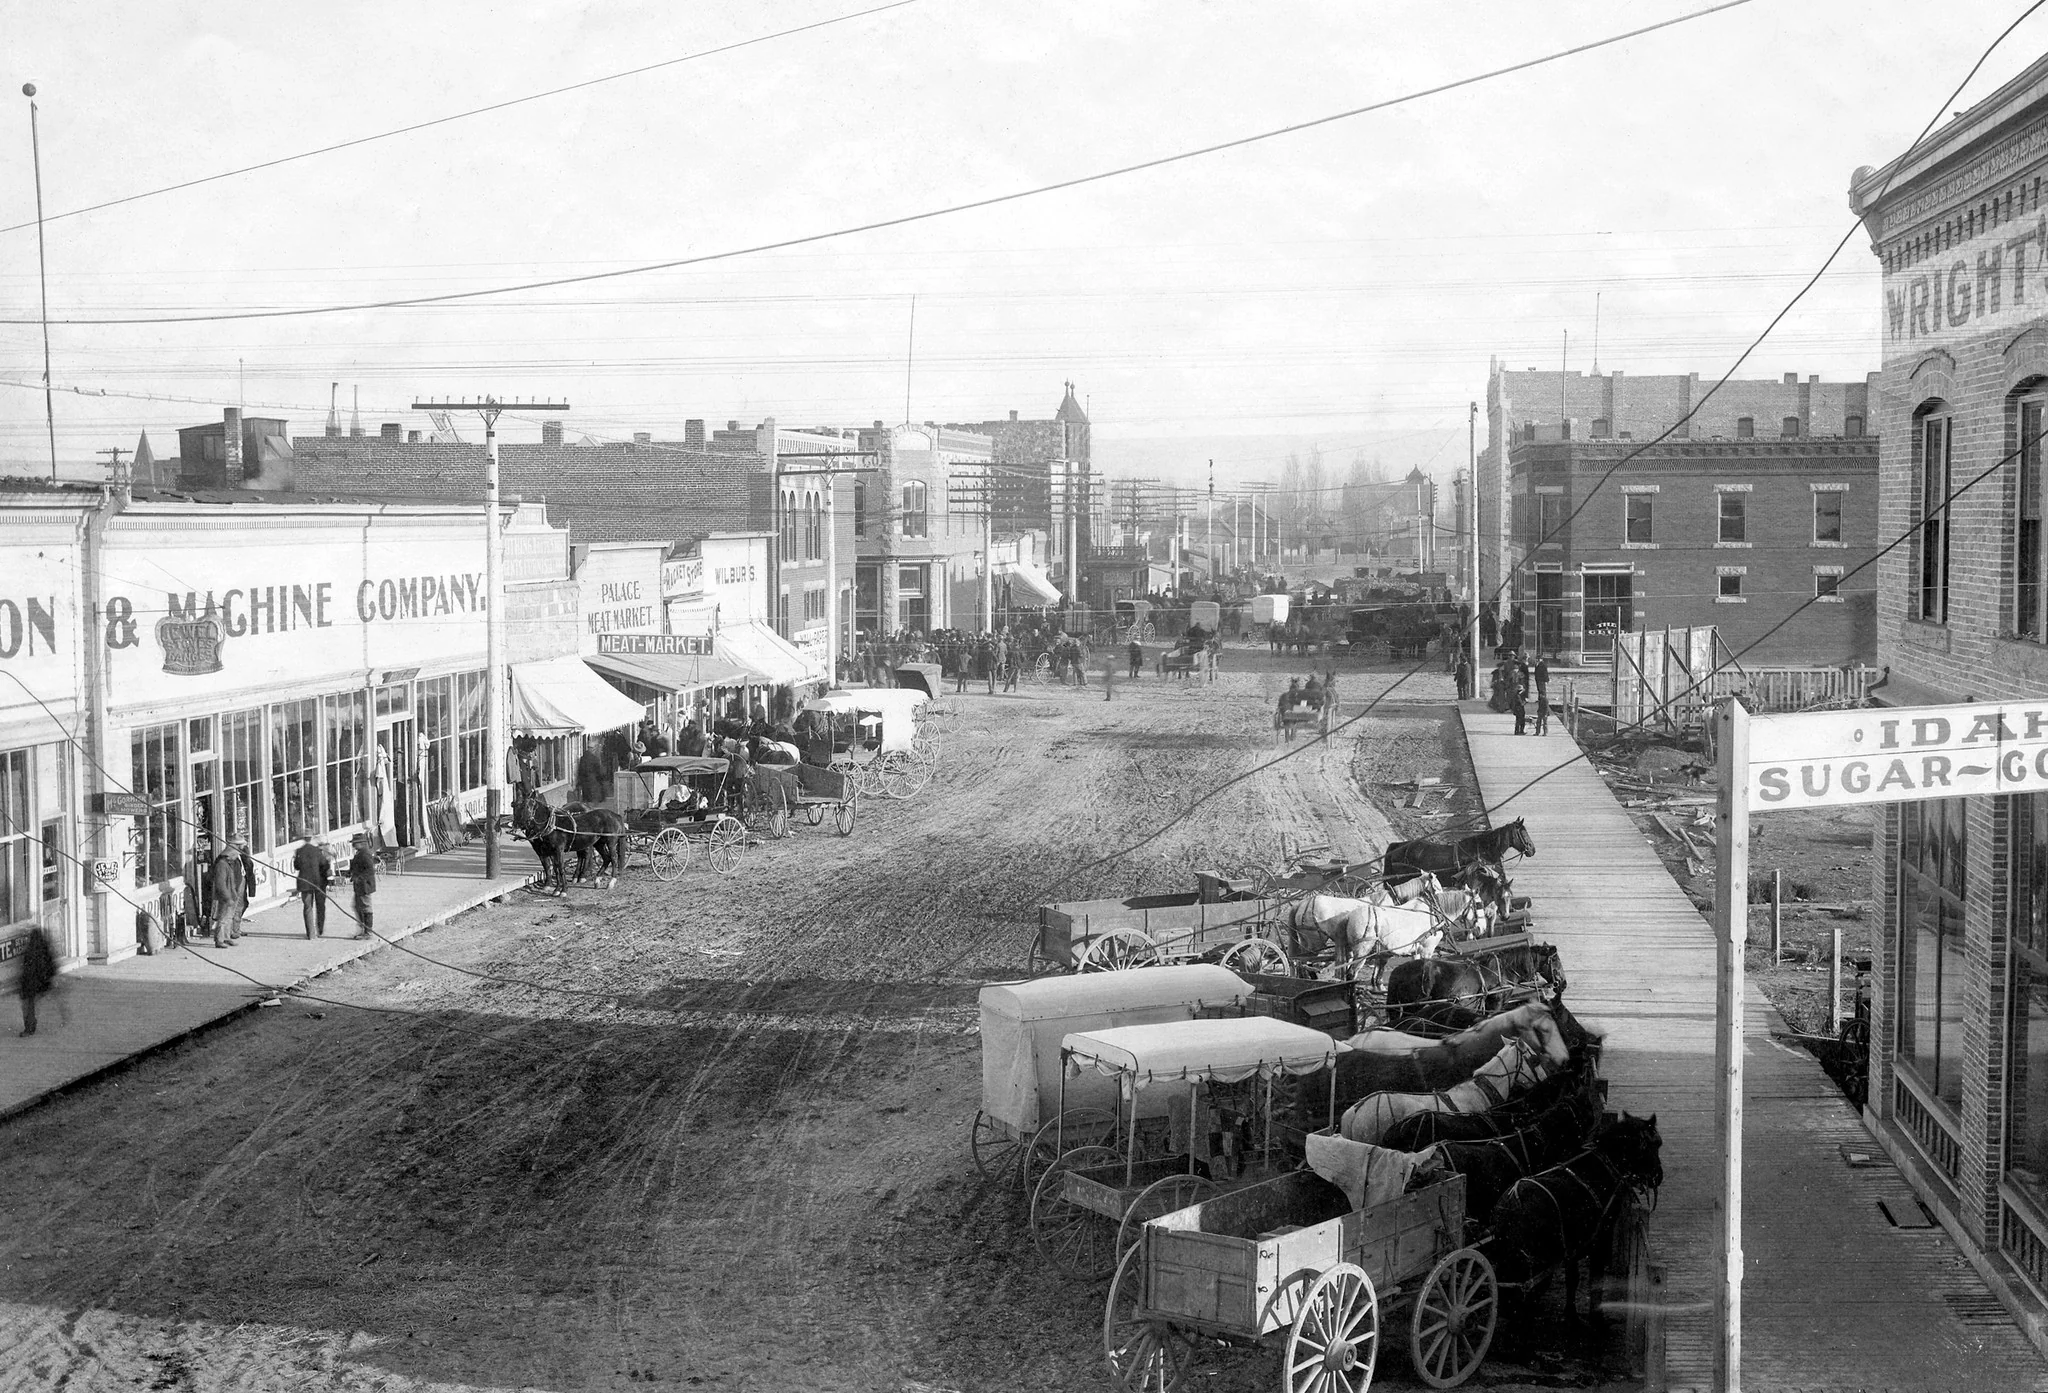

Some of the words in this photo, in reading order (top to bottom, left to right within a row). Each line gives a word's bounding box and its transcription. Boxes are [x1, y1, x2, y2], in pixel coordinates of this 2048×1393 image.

[1886, 214, 2048, 344] WRIGHT'
[687, 561, 702, 587] STORE
[601, 581, 641, 603] PALACE
[105, 597, 139, 649] &
[162, 622, 215, 640] JEWEL
[588, 610, 611, 634] MEAT
[166, 638, 214, 650] STOVES
